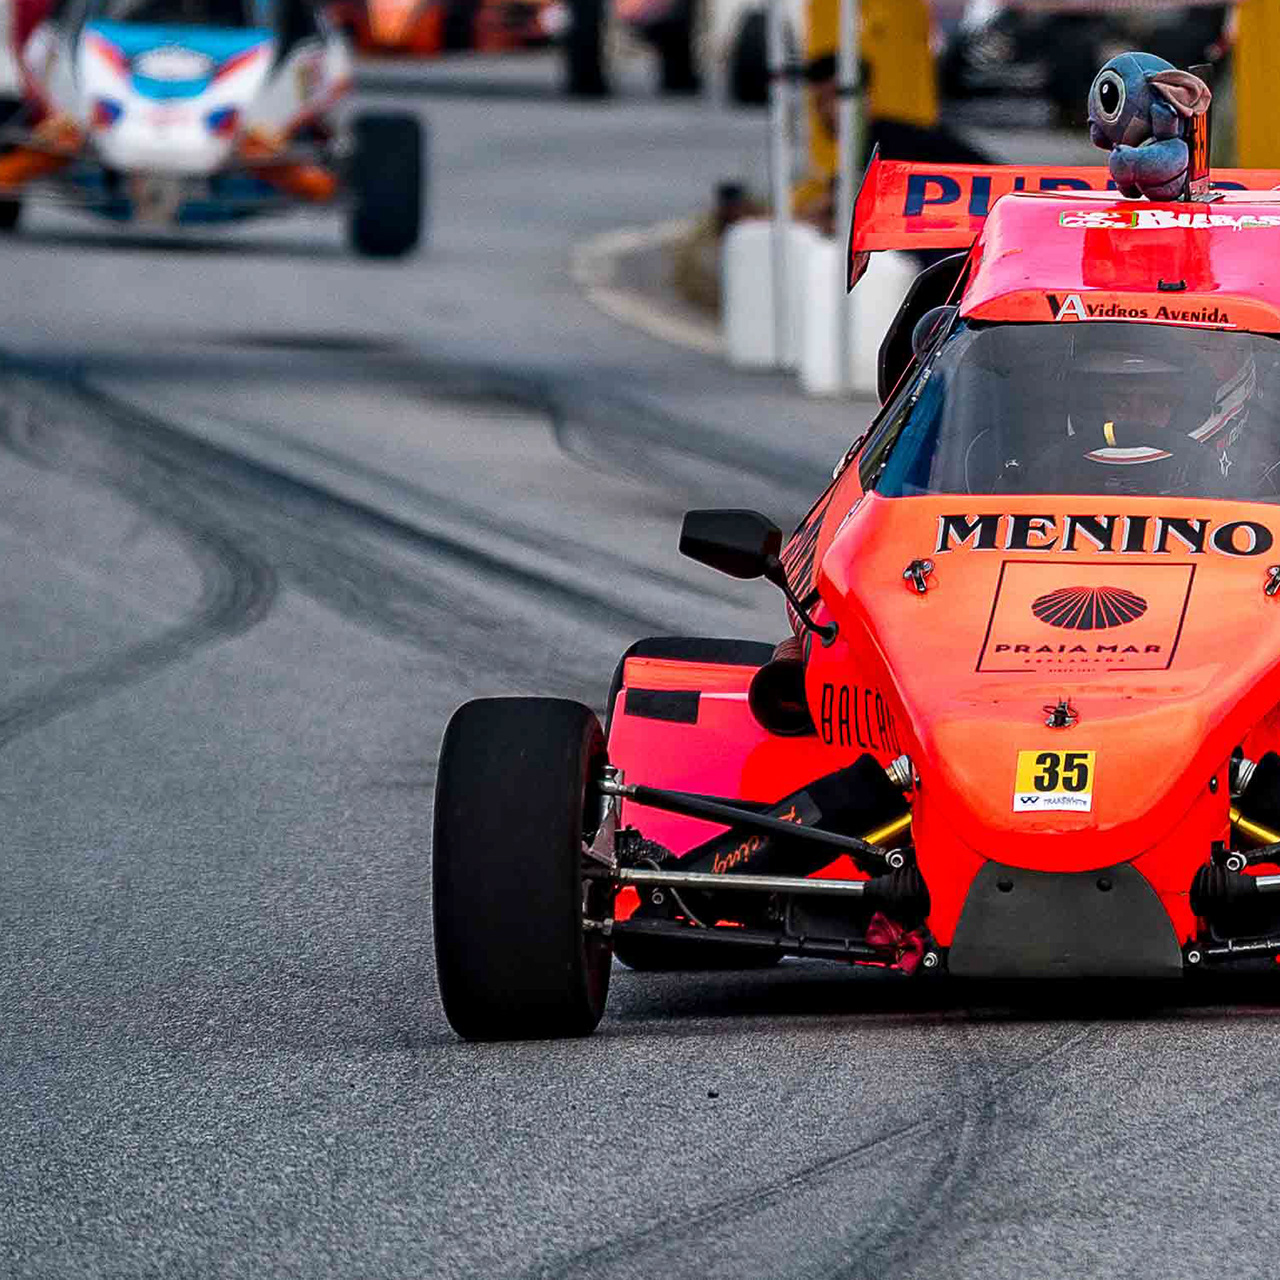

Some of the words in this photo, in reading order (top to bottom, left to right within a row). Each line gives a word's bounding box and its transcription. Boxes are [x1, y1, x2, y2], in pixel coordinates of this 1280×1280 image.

[934, 514, 1275, 556] MENINO
[995, 644, 1087, 653] PRAIA
[1096, 644, 1162, 653] MAR
[1033, 752, 1089, 792] 35
